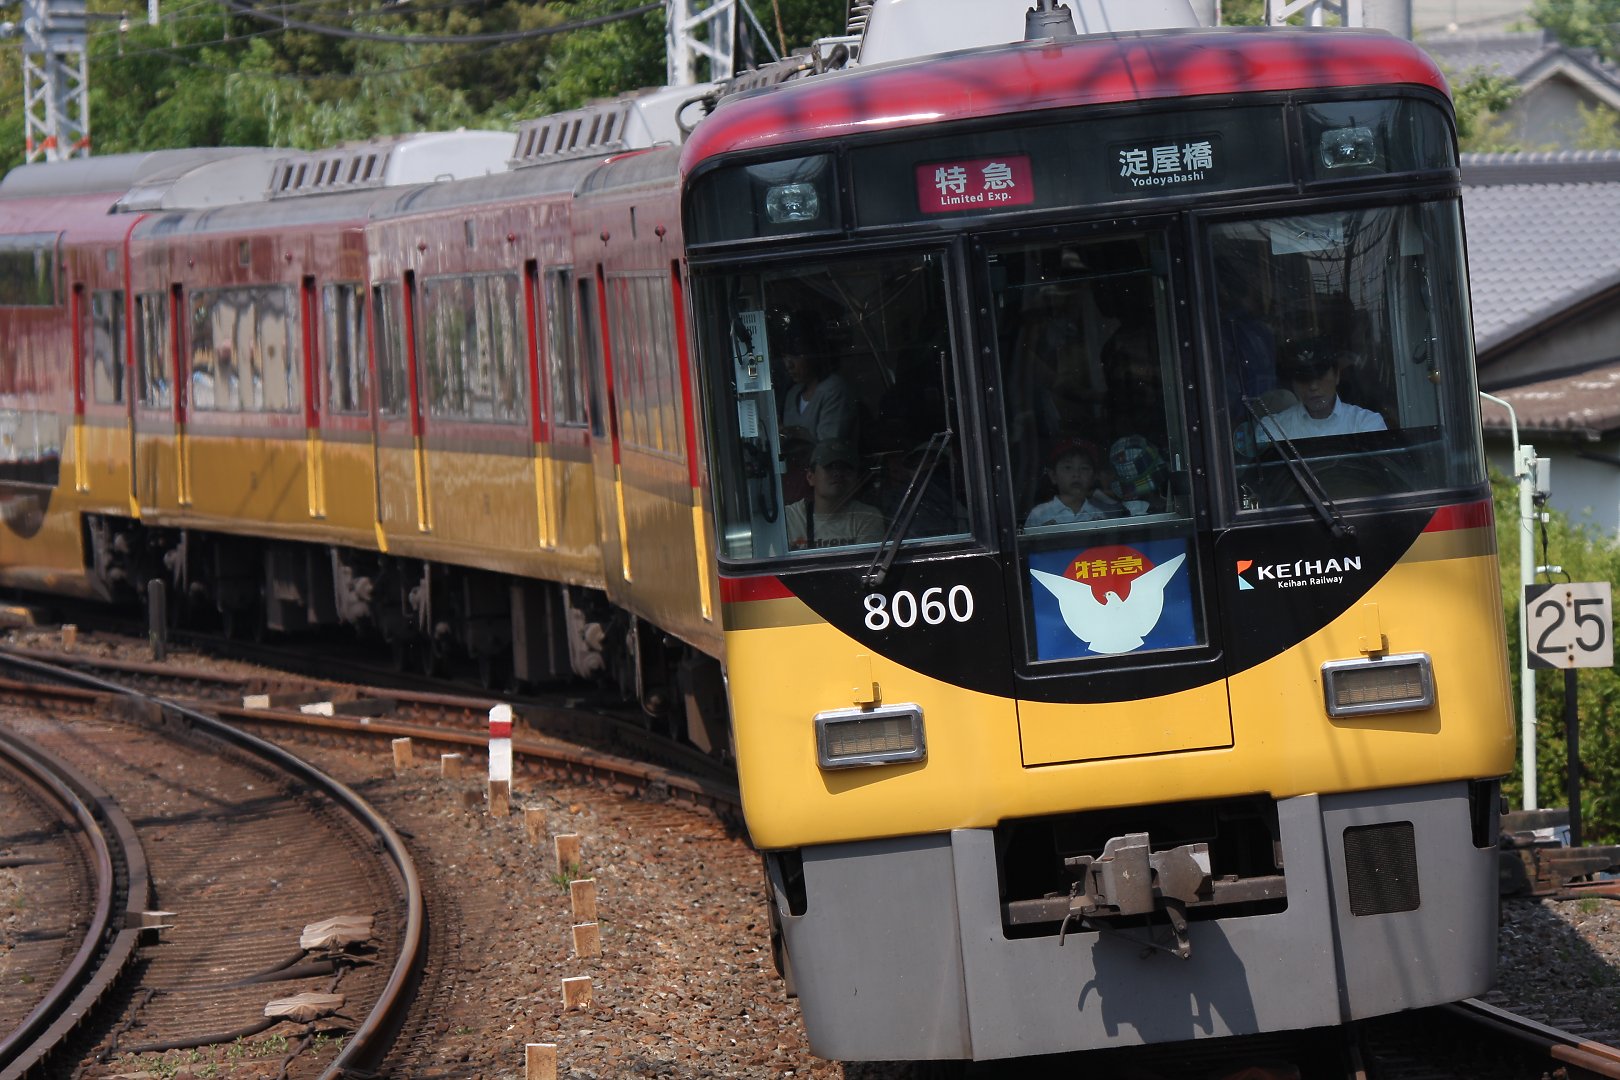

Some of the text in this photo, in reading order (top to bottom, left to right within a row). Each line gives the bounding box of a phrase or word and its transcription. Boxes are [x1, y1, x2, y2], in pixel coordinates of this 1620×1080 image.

[1119, 141, 1213, 177] 淀屋橋
[935, 162, 1015, 195] 特急
[1131, 171, 1204, 187] Yodoyabashi
[941, 192, 1012, 205] Limited Exp.
[1075, 556, 1143, 580] 特急
[1257, 556, 1362, 580] KEIHAN
[1278, 576, 1344, 588] Keihan Railway
[863, 584, 974, 631] 8060
[1535, 598, 1605, 653] 25
